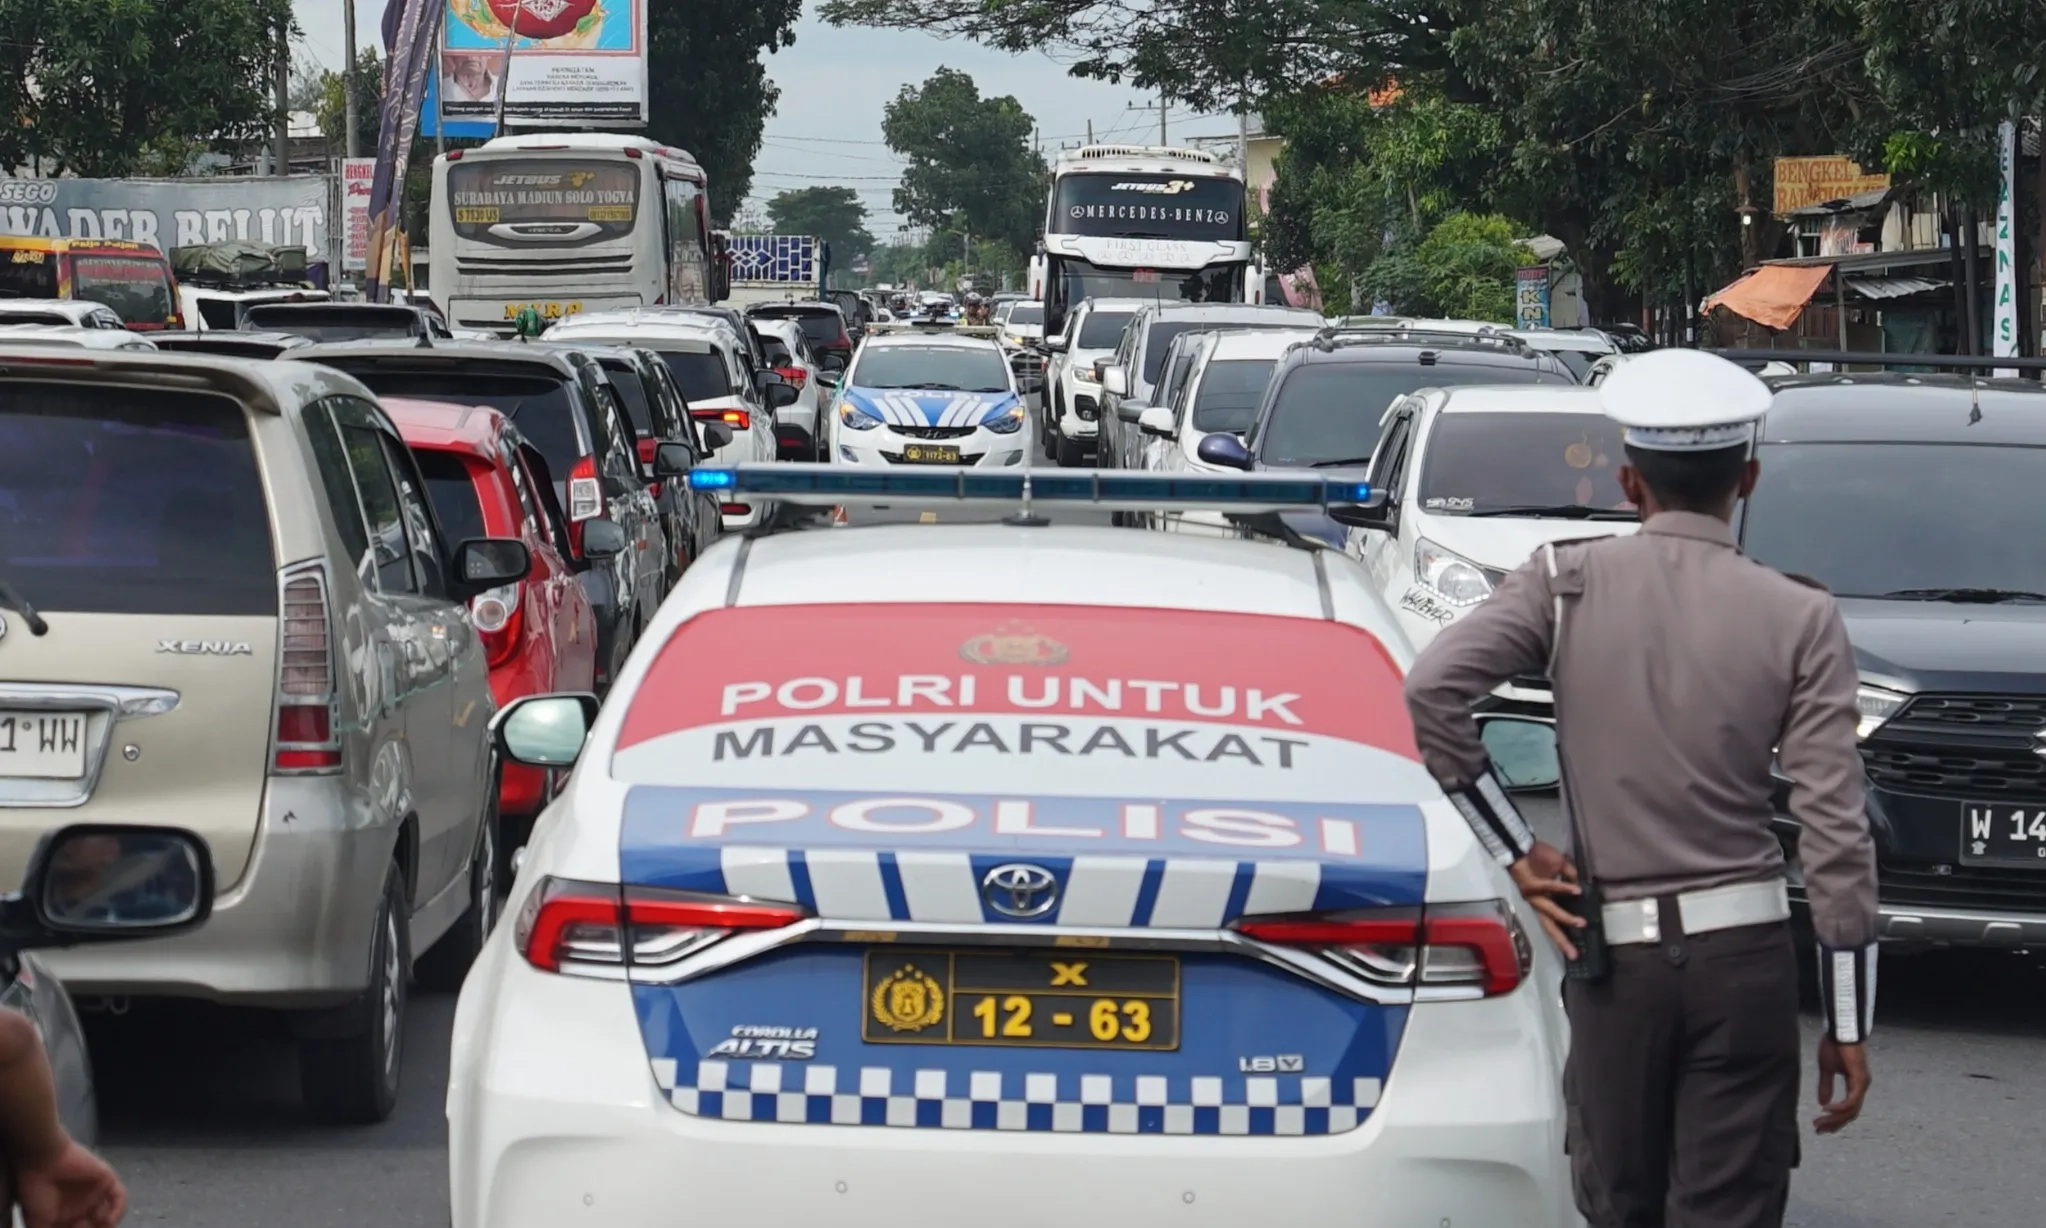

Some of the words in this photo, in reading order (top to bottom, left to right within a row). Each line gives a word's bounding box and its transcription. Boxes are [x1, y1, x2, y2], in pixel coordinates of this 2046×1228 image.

[1777, 161, 1853, 183] BENGKEL
[1, 183, 55, 201] SEGO
[454, 192, 514, 205] SURABAYA
[517, 191, 563, 204] MADIUN
[566, 191, 594, 204] SOLO
[597, 190, 634, 203] YOGYA
[1087, 205, 1213, 223] MERCEDES-BENZ
[1107, 240, 1142, 252] FIRST
[1146, 241, 1188, 253] CLASS
[156, 640, 251, 655] XENIA
[719, 674, 975, 716] POLRI
[1007, 674, 1304, 726] UNTUK
[39, 718, 79, 752] WW
[711, 722, 1311, 769] MASYARAKAT
[686, 798, 1362, 858] POLISI
[1971, 809, 1992, 839] W
[2010, 810, 2046, 841] 14
[1050, 962, 1089, 986] X
[973, 995, 1032, 1038] 12
[1089, 1000, 1151, 1042] 63
[731, 1025, 818, 1040] COROLLA
[709, 1039, 816, 1058] ALTIS
